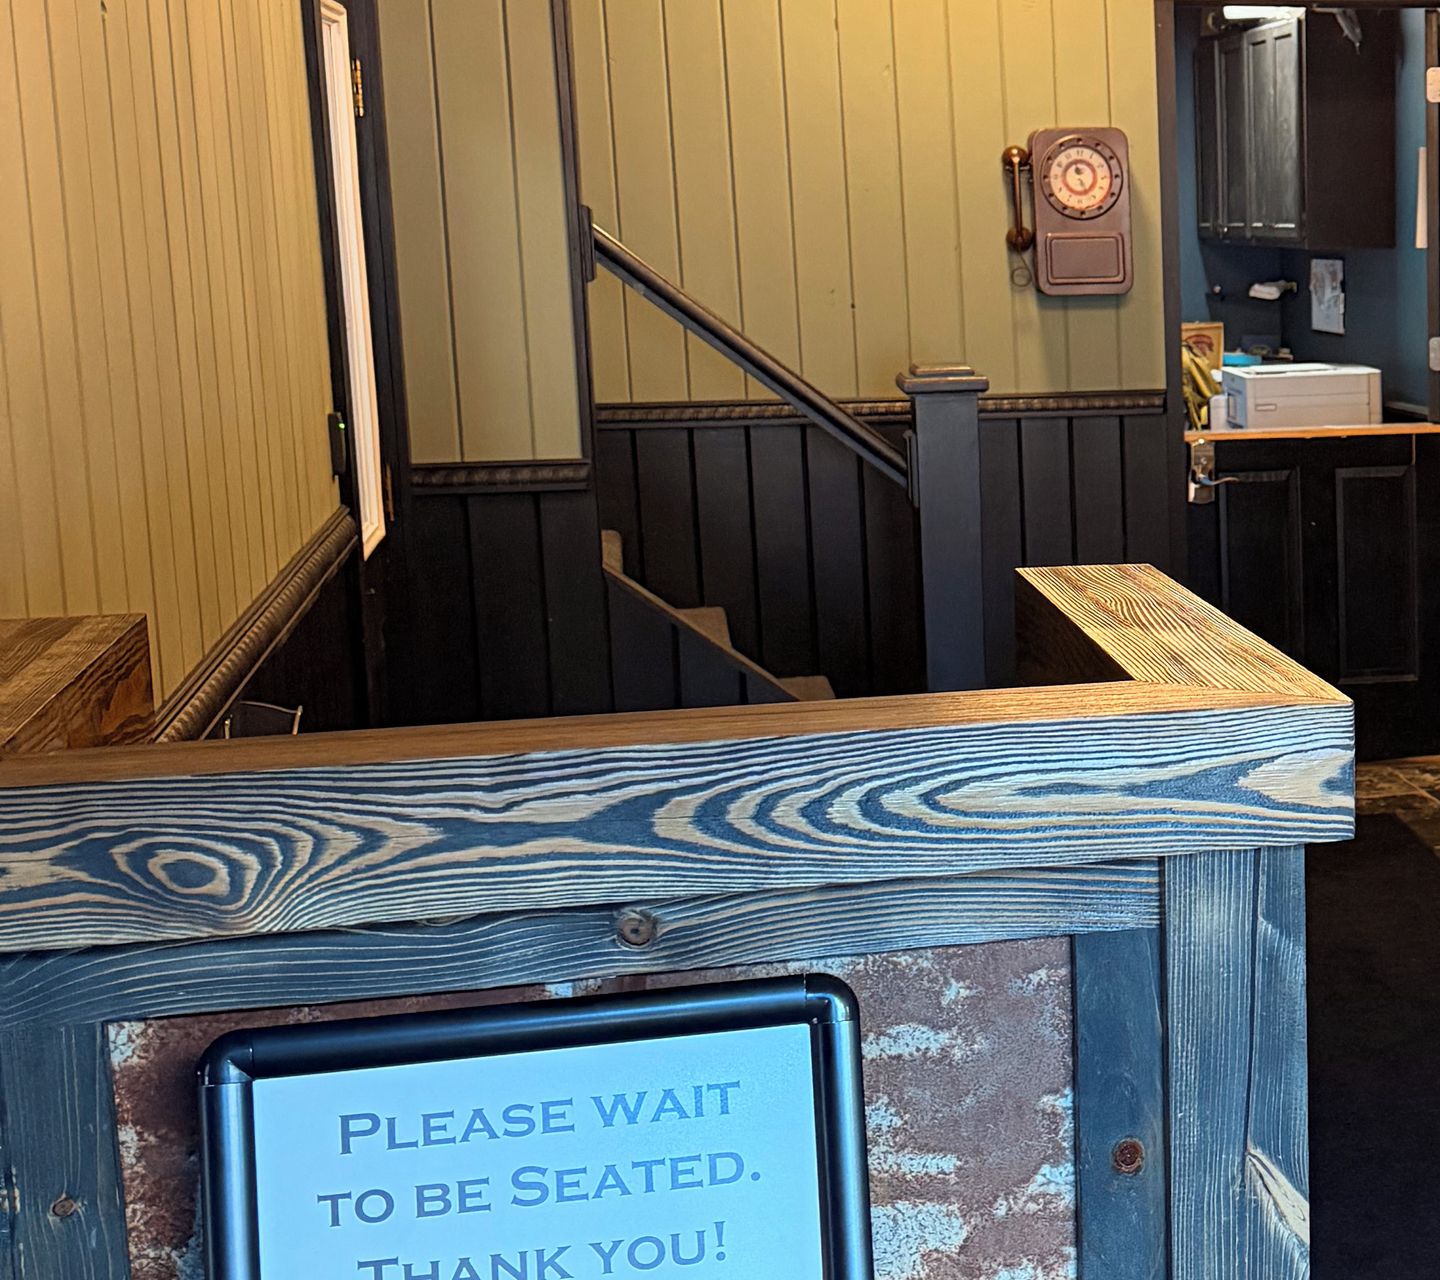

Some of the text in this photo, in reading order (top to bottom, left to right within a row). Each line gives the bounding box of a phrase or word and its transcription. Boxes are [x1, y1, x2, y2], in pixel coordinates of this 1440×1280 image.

[338, 1080, 741, 1155] PLEASE WAIT
[316, 1151, 761, 1227] TO BE SEATED.
[588, 1221, 726, 1274] YOU!
